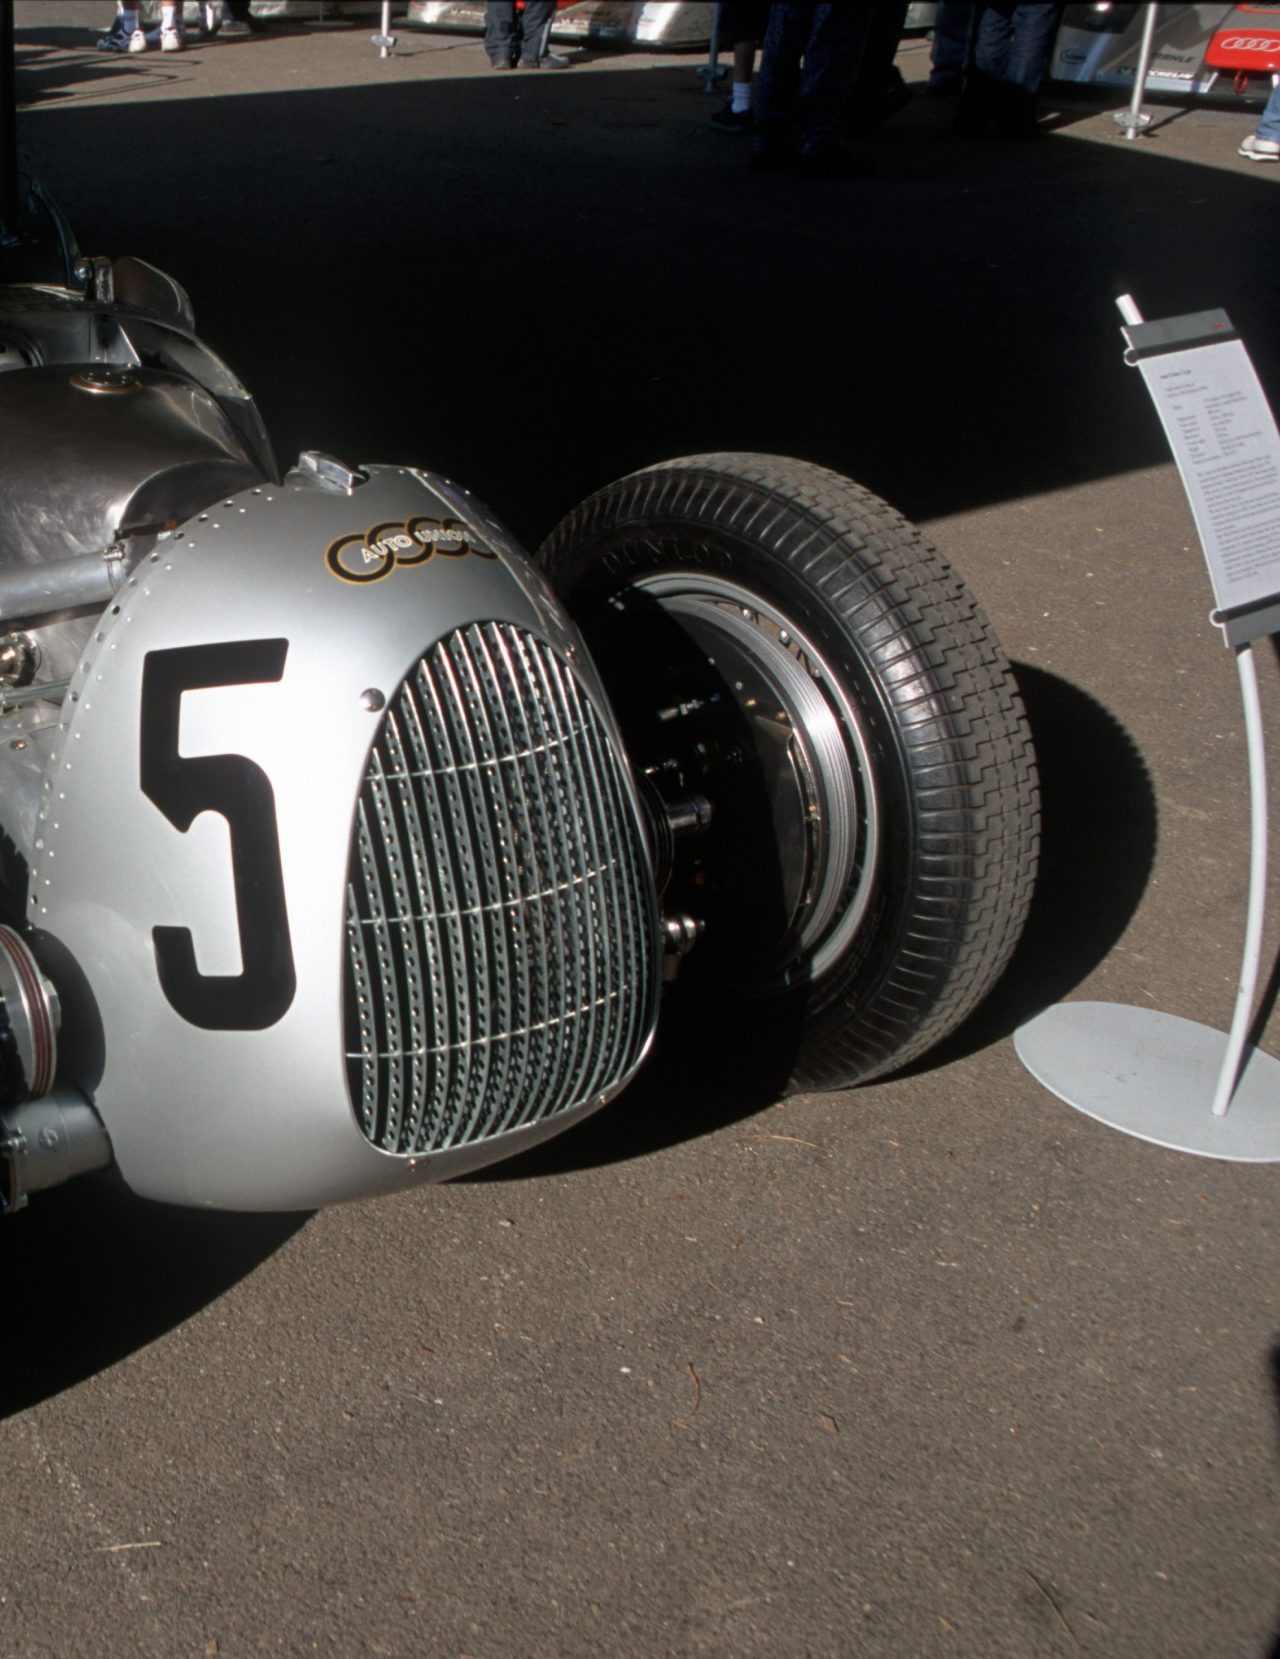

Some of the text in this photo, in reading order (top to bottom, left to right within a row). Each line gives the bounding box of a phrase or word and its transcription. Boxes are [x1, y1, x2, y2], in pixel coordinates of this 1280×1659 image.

[360, 529, 477, 564] AUTO UNION
[140, 638, 297, 1031] 5
